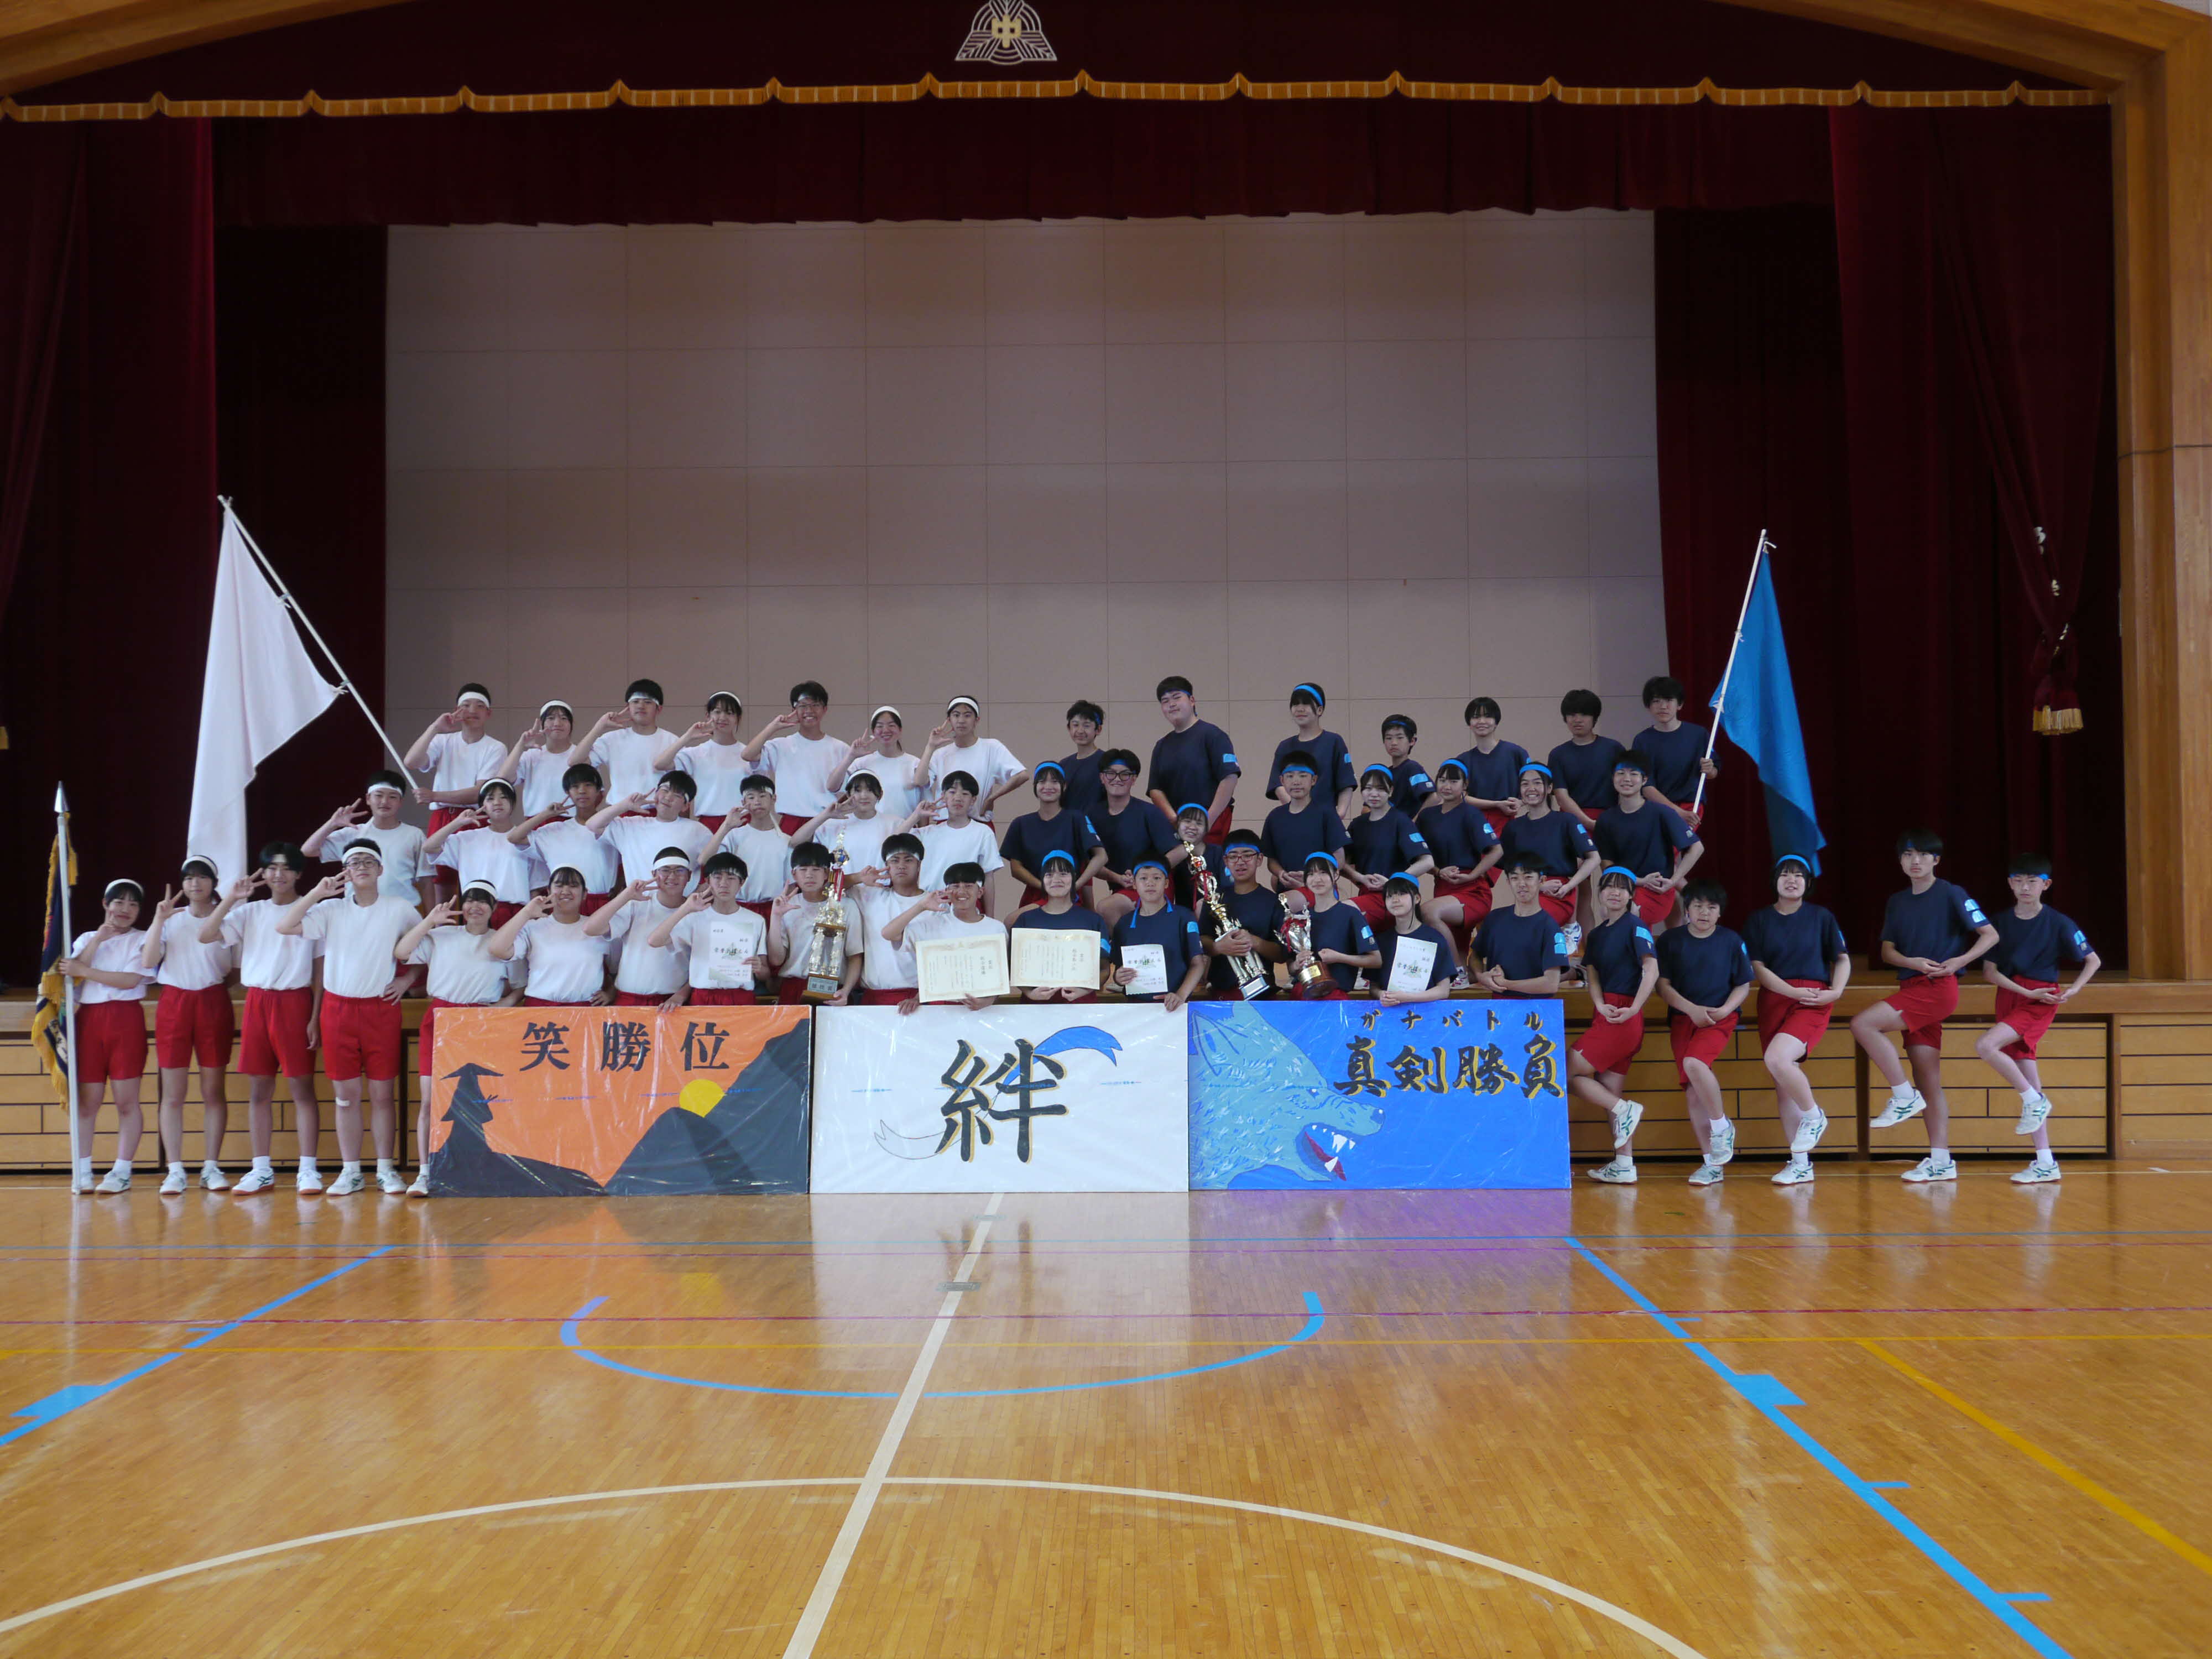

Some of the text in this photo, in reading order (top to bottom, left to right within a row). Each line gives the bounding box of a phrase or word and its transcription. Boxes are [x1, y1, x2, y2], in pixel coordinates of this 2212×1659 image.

[520, 1021, 730, 1072] 笑勝位
[1333, 1034, 1564, 1099] 真剣勝負
[935, 1039, 1068, 1164] 絆
